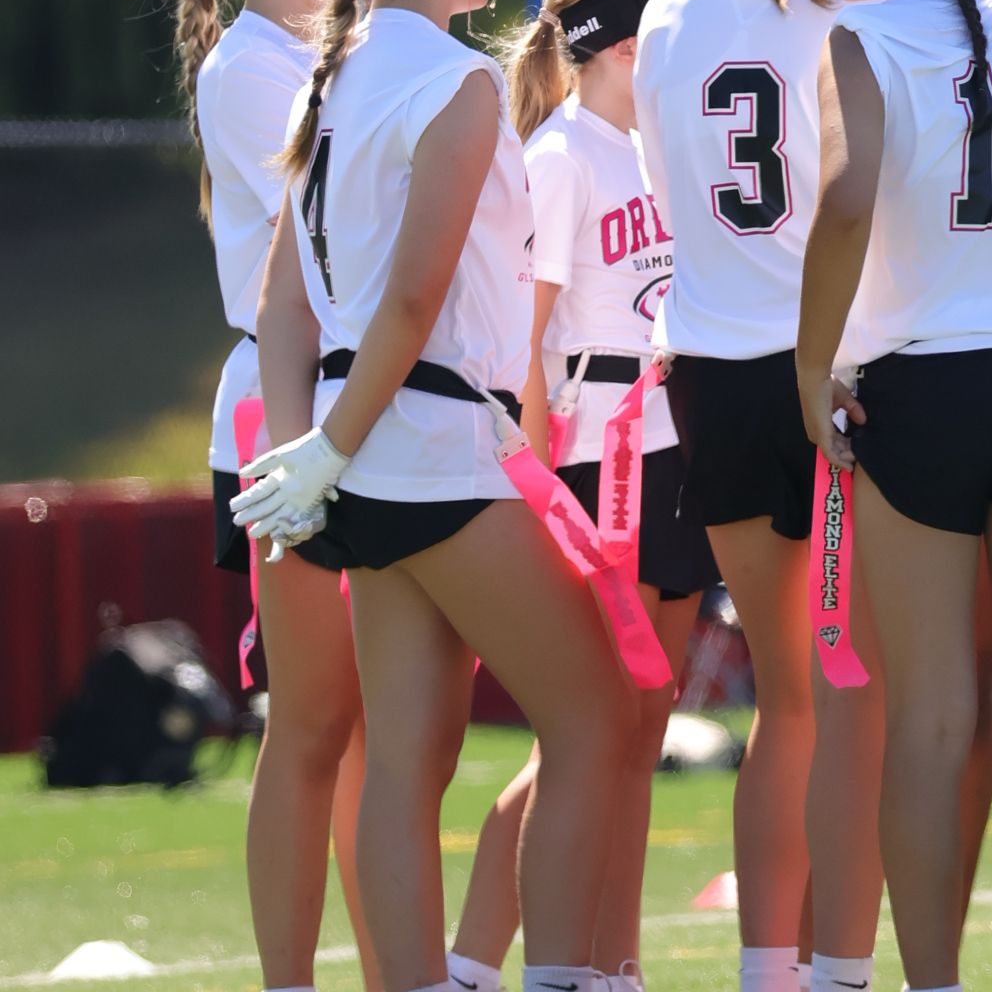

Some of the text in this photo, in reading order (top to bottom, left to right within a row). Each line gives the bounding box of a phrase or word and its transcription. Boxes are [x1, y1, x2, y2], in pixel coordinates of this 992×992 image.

[300, 128, 336, 304] 4
[702, 61, 793, 236] 3
[822, 554, 839, 611] ELITE
